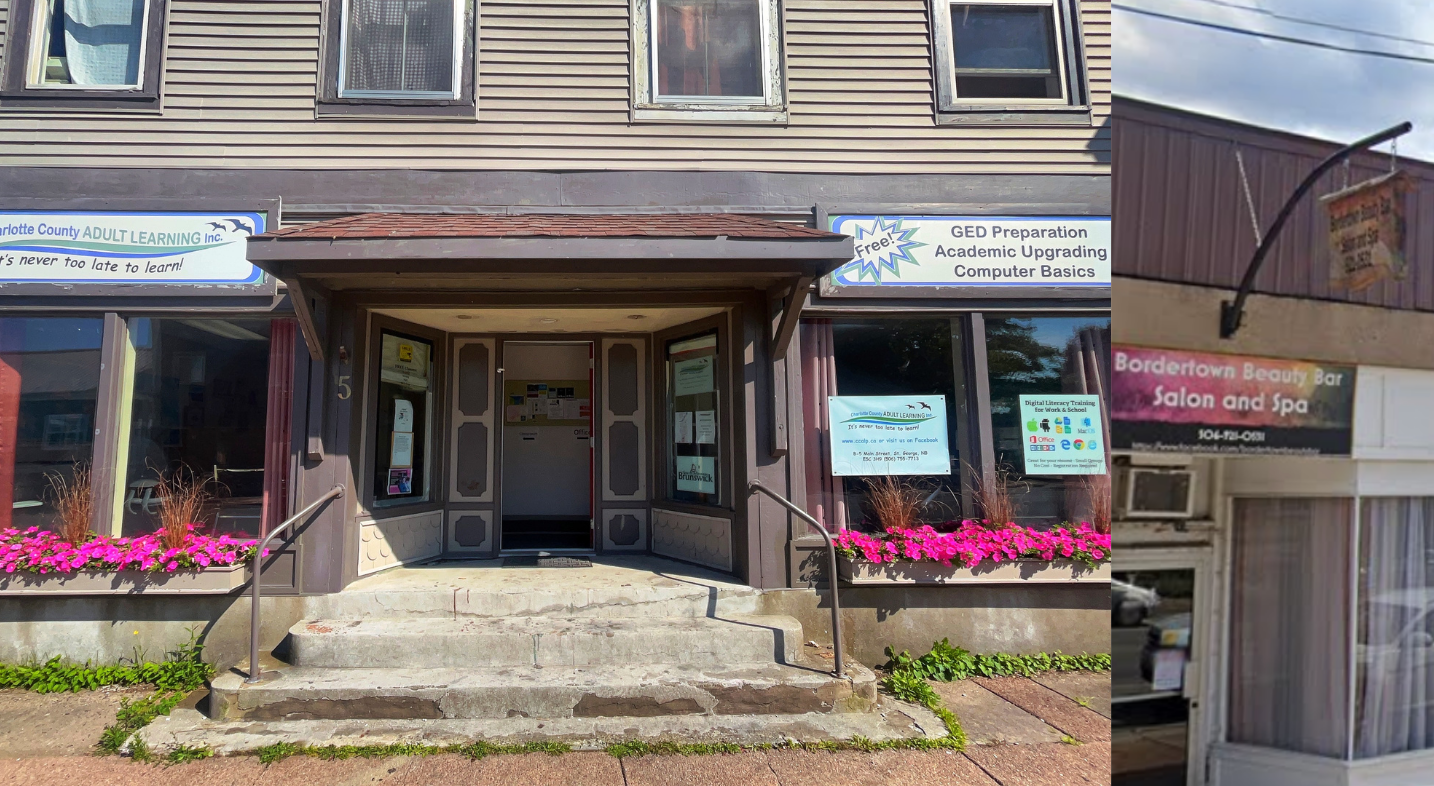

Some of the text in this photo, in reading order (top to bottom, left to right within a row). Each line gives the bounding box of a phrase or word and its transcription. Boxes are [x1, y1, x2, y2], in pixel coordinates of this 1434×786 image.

[0, 223, 223, 245] rlotte County ADULT LEARNING Inc.
[951, 225, 1088, 241] GED Preparation
[854, 231, 895, 258] Free!
[935, 245, 1108, 261] Academic Upgrading
[19, 256, 58, 266] never
[64, 257, 86, 269] too
[91, 258, 118, 272] late
[125, 262, 139, 273] to
[145, 257, 184, 274] learn!
[954, 265, 1096, 280] Computer Basics
[1114, 352, 1343, 389] Bordertown Beauty Bar
[337, 375, 352, 400] 5
[1153, 386, 1309, 416] Salon and Spa
[678, 471, 713, 483] Brunswick
